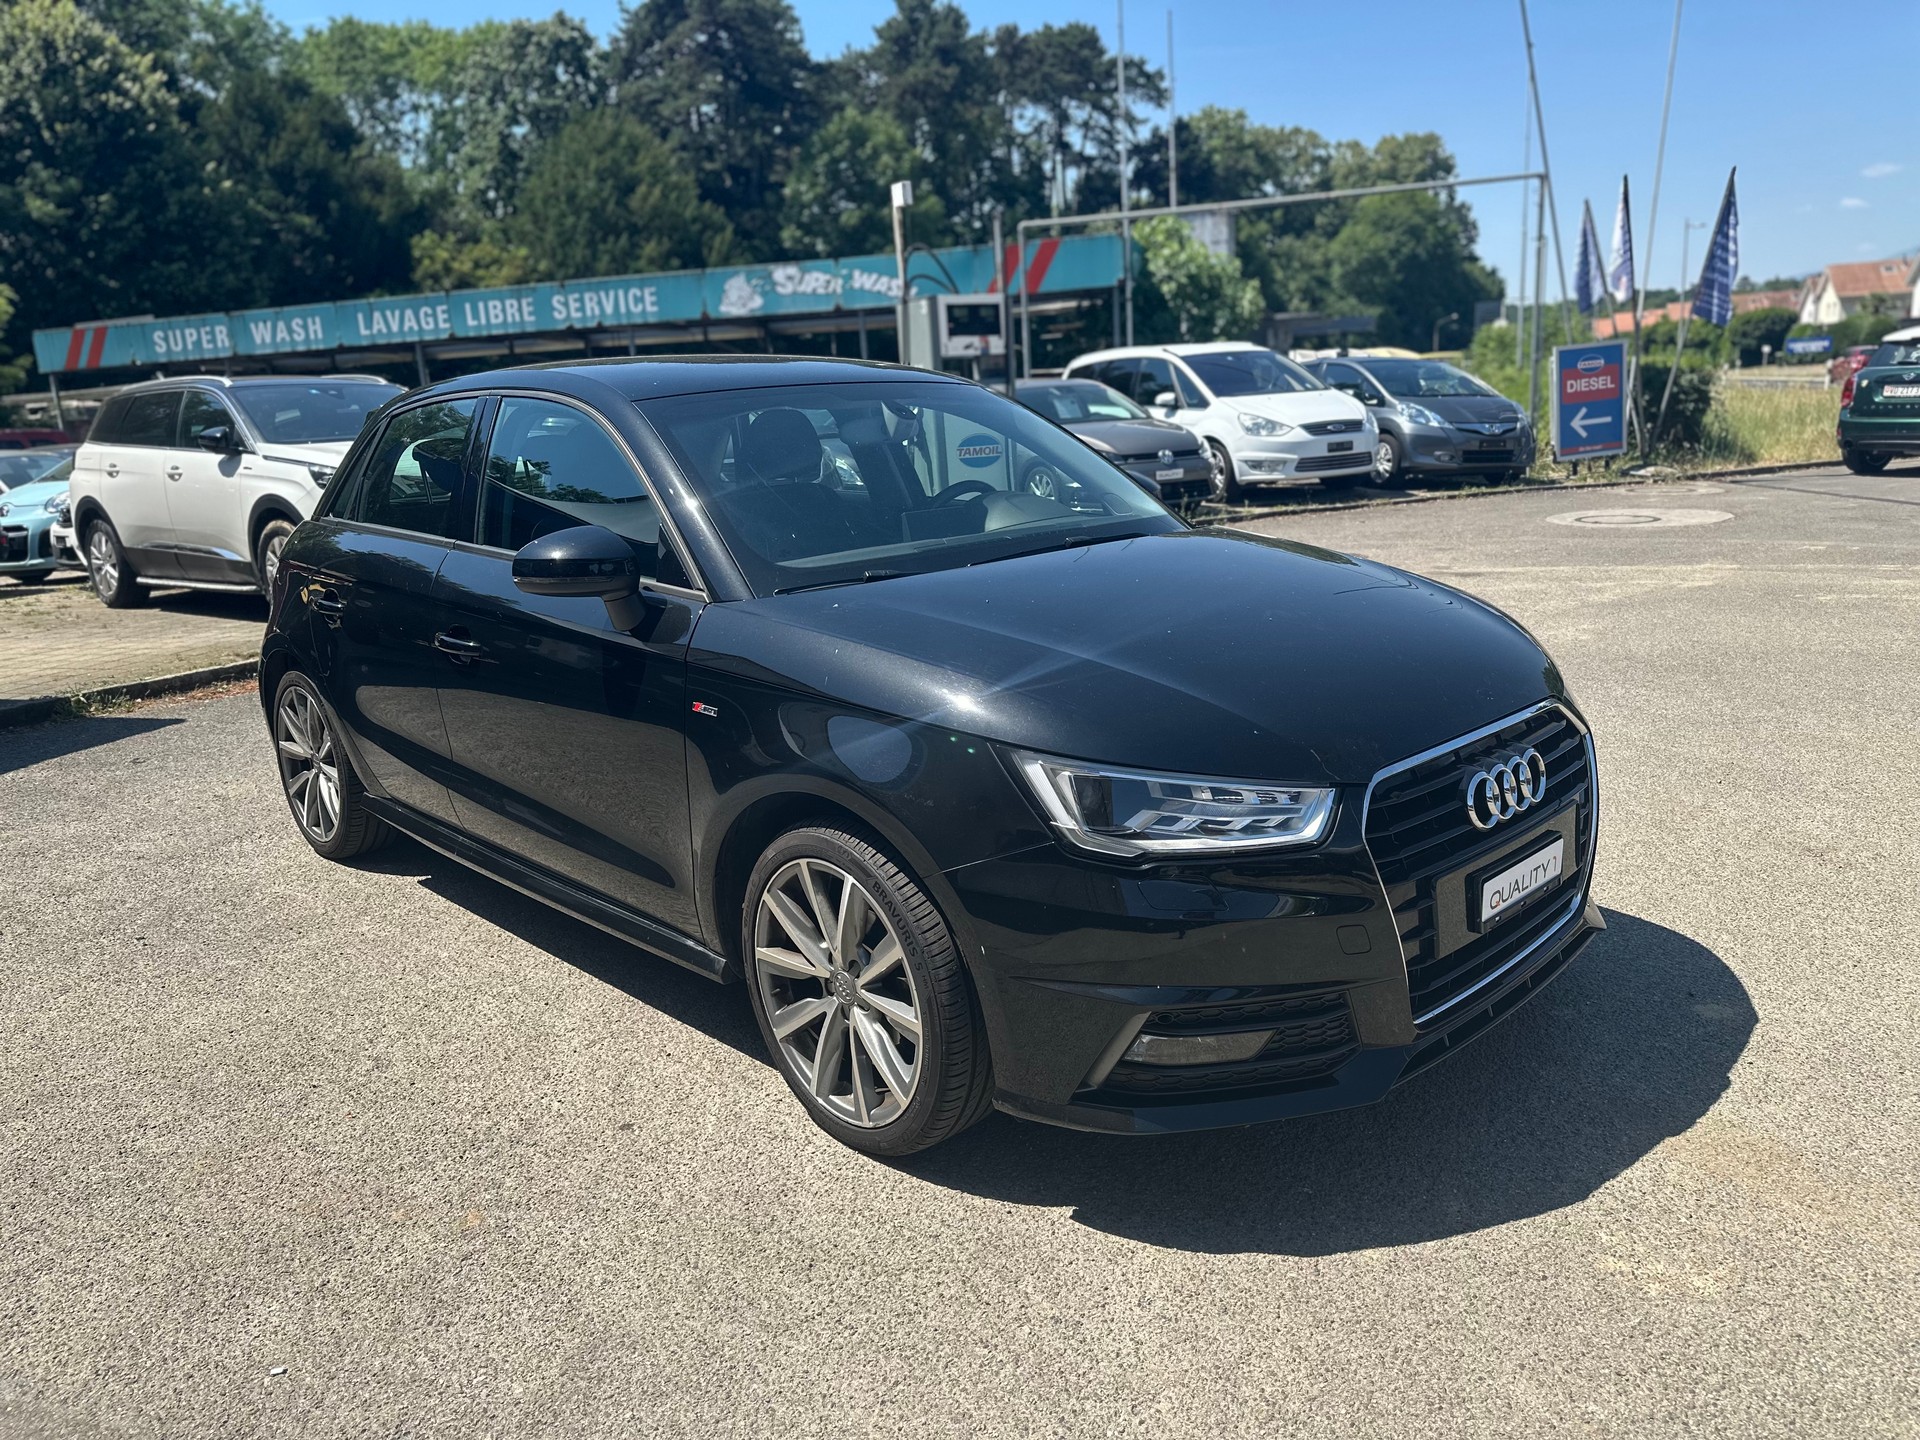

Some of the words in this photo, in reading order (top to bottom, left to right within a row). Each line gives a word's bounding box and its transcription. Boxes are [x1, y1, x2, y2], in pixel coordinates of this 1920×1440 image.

[771, 264, 843, 296] SUPER
[852, 268, 918, 298] WAS
[152, 324, 230, 354] SUPER
[250, 315, 323, 345] WASH
[356, 304, 451, 337] LAVAGE
[464, 297, 536, 327] LIBRE
[551, 286, 659, 321] SERVICE
[1566, 375, 1616, 394] DIESEL
[956, 446, 1003, 458] TAMOIL
[1489, 858, 1551, 911] QUALITY
[871, 880, 919, 958] BRAVURIS
